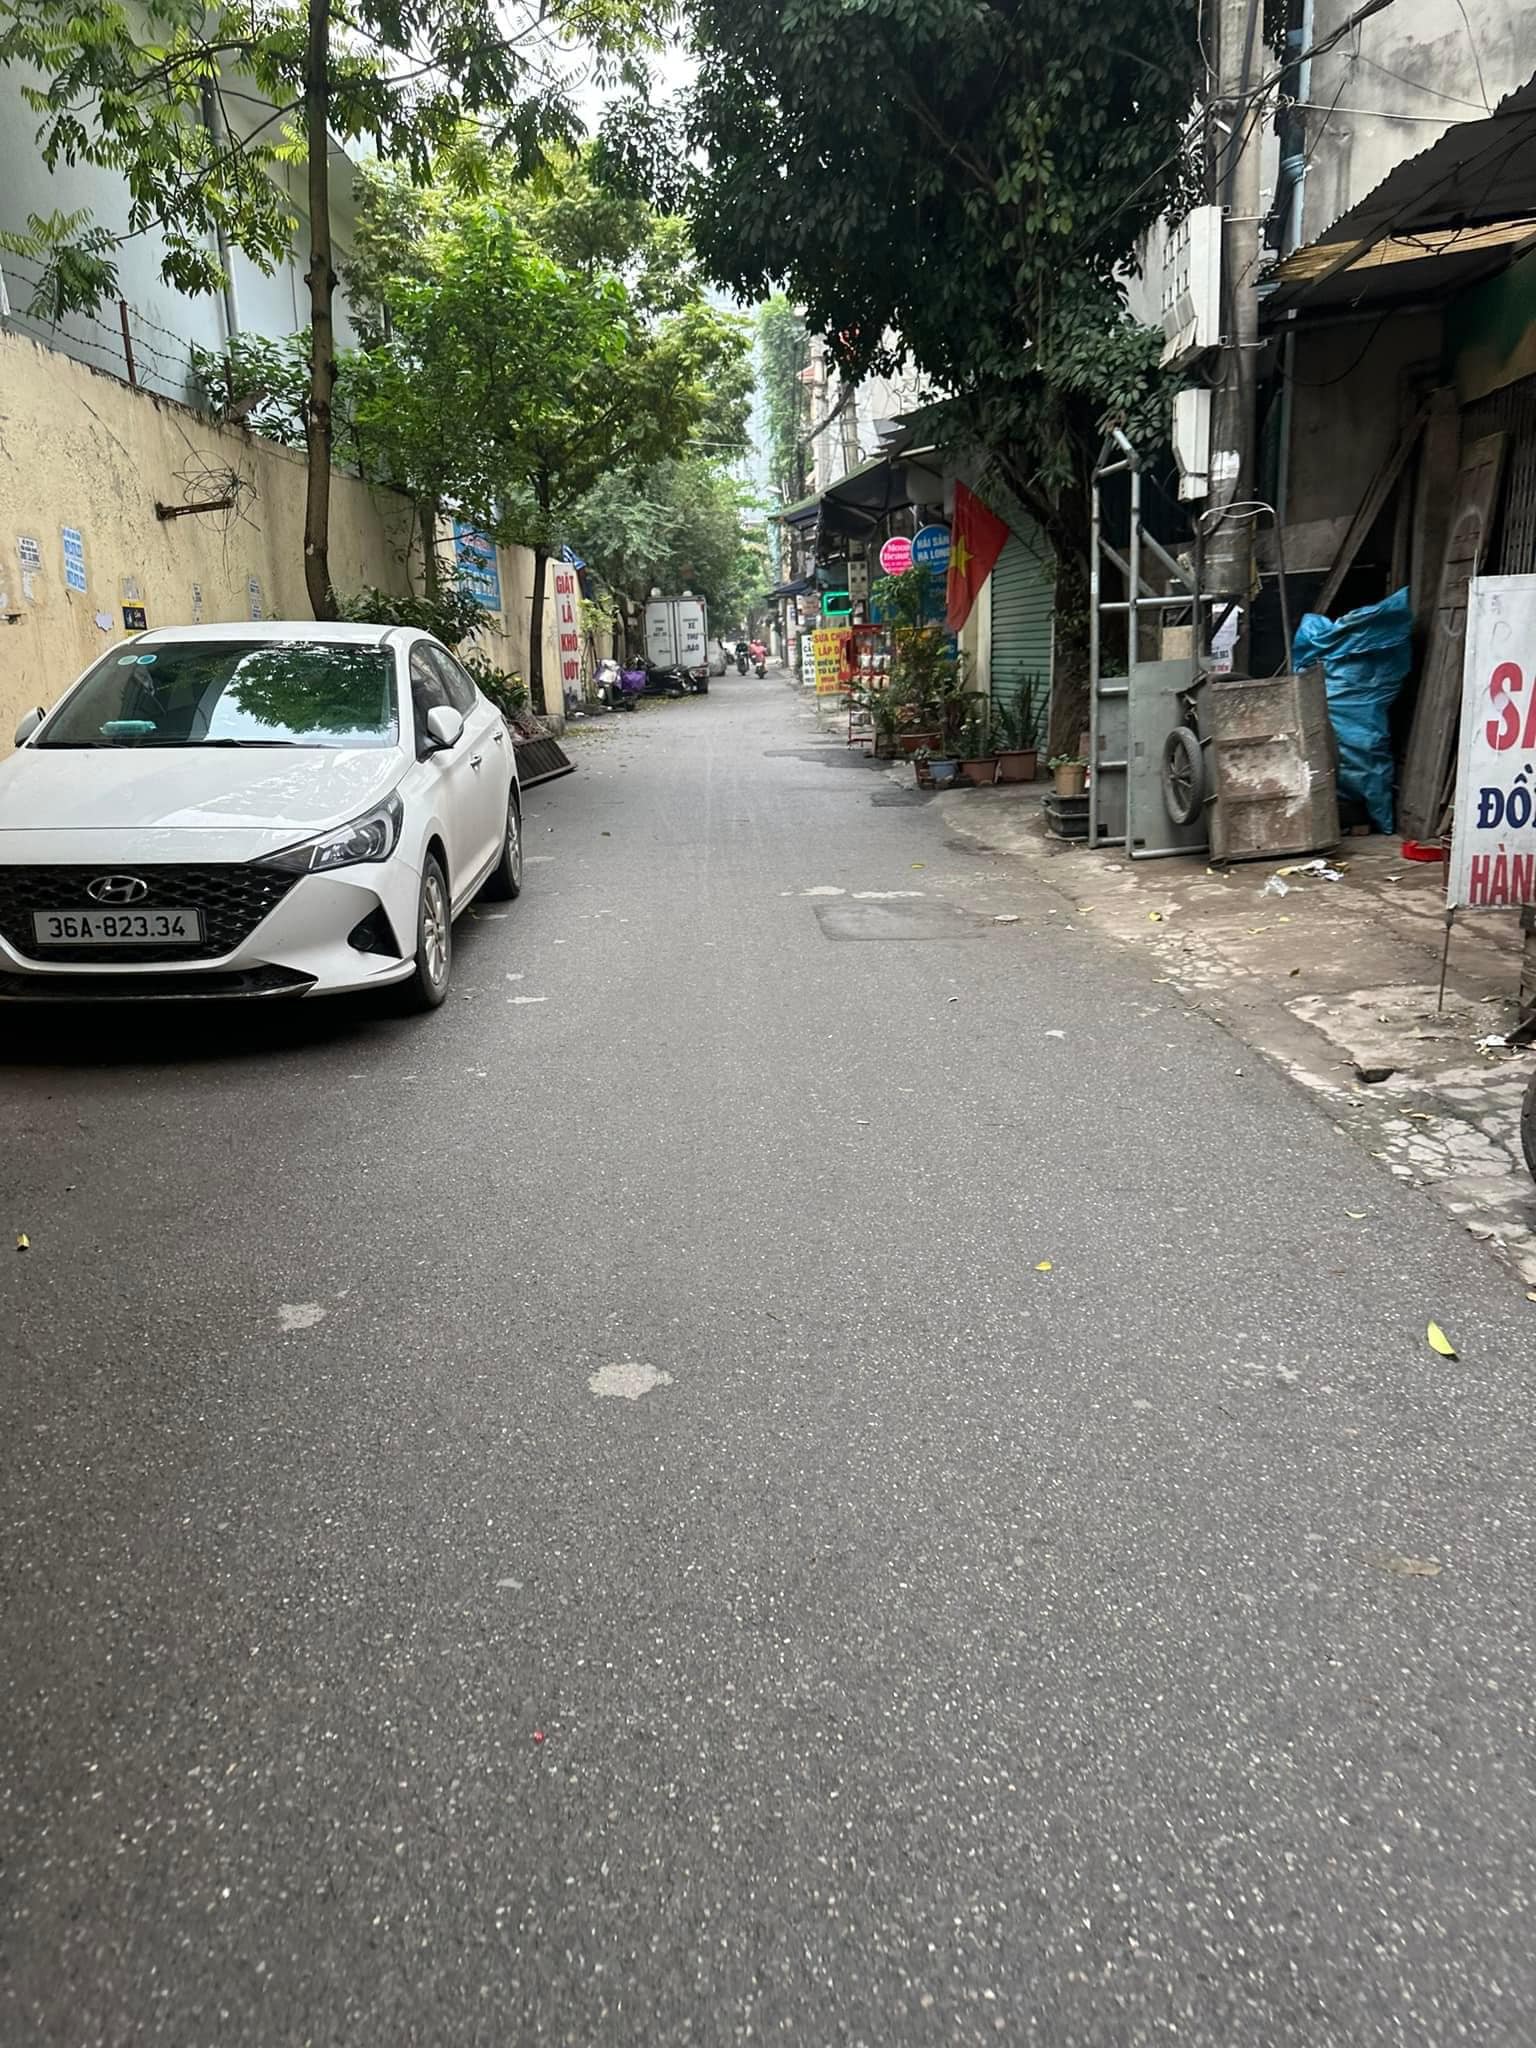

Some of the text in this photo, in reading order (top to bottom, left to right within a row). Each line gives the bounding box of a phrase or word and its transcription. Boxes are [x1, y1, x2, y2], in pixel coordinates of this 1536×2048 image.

[556, 572, 574, 598] GIẶT
[560, 629, 577, 651] KHÔ
[1477, 763, 1536, 829] ĐỒ
[1469, 843, 1536, 906] HÀN
[48, 915, 186, 938] 36A-823.34
